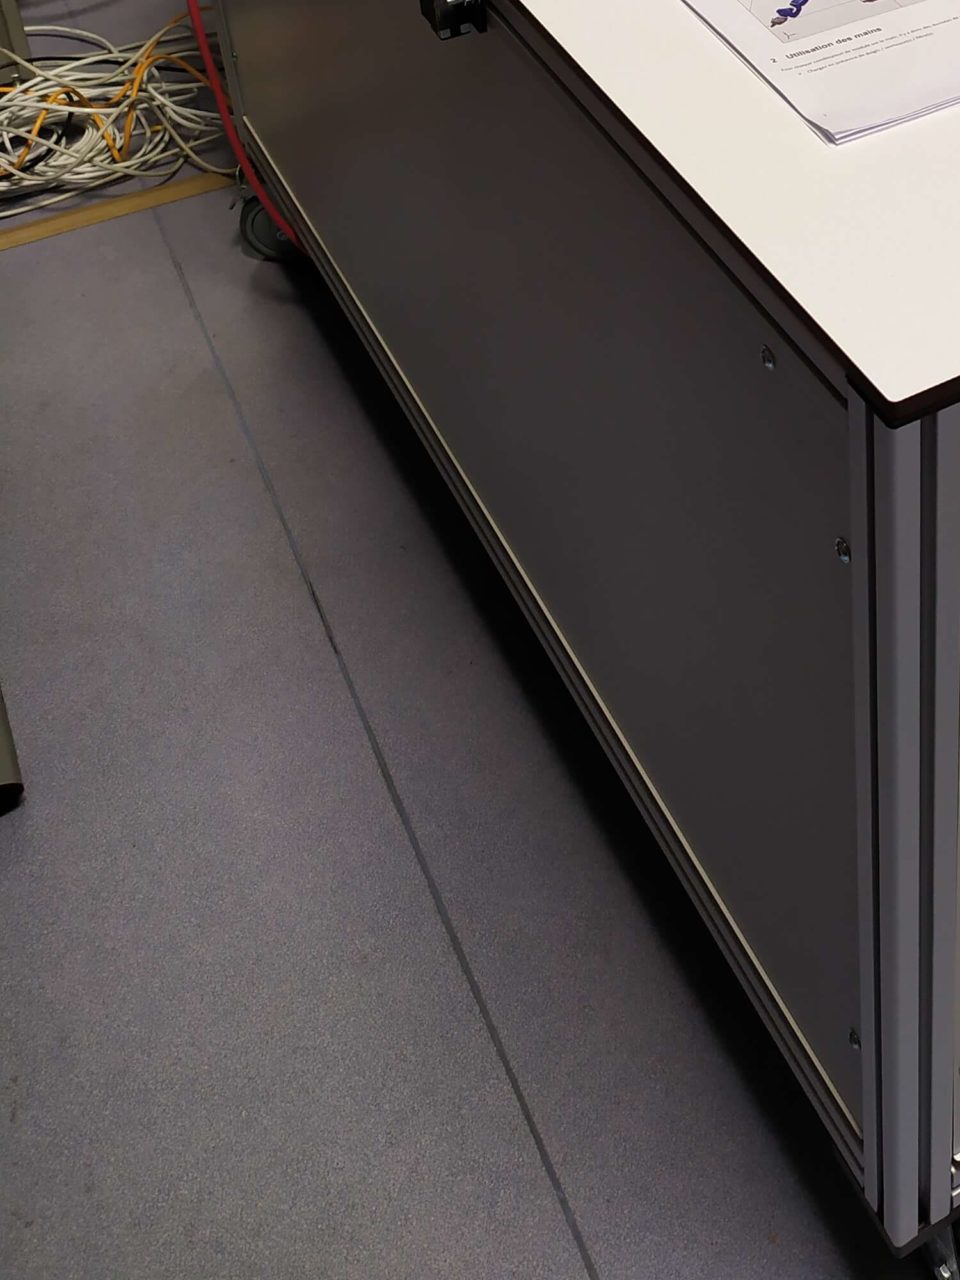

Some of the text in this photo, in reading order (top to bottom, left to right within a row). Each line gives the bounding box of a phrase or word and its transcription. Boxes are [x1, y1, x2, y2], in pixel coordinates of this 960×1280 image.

[784, 42, 835, 60] Utilisation
[835, 35, 853, 45] des
[854, 26, 882, 39] mains
